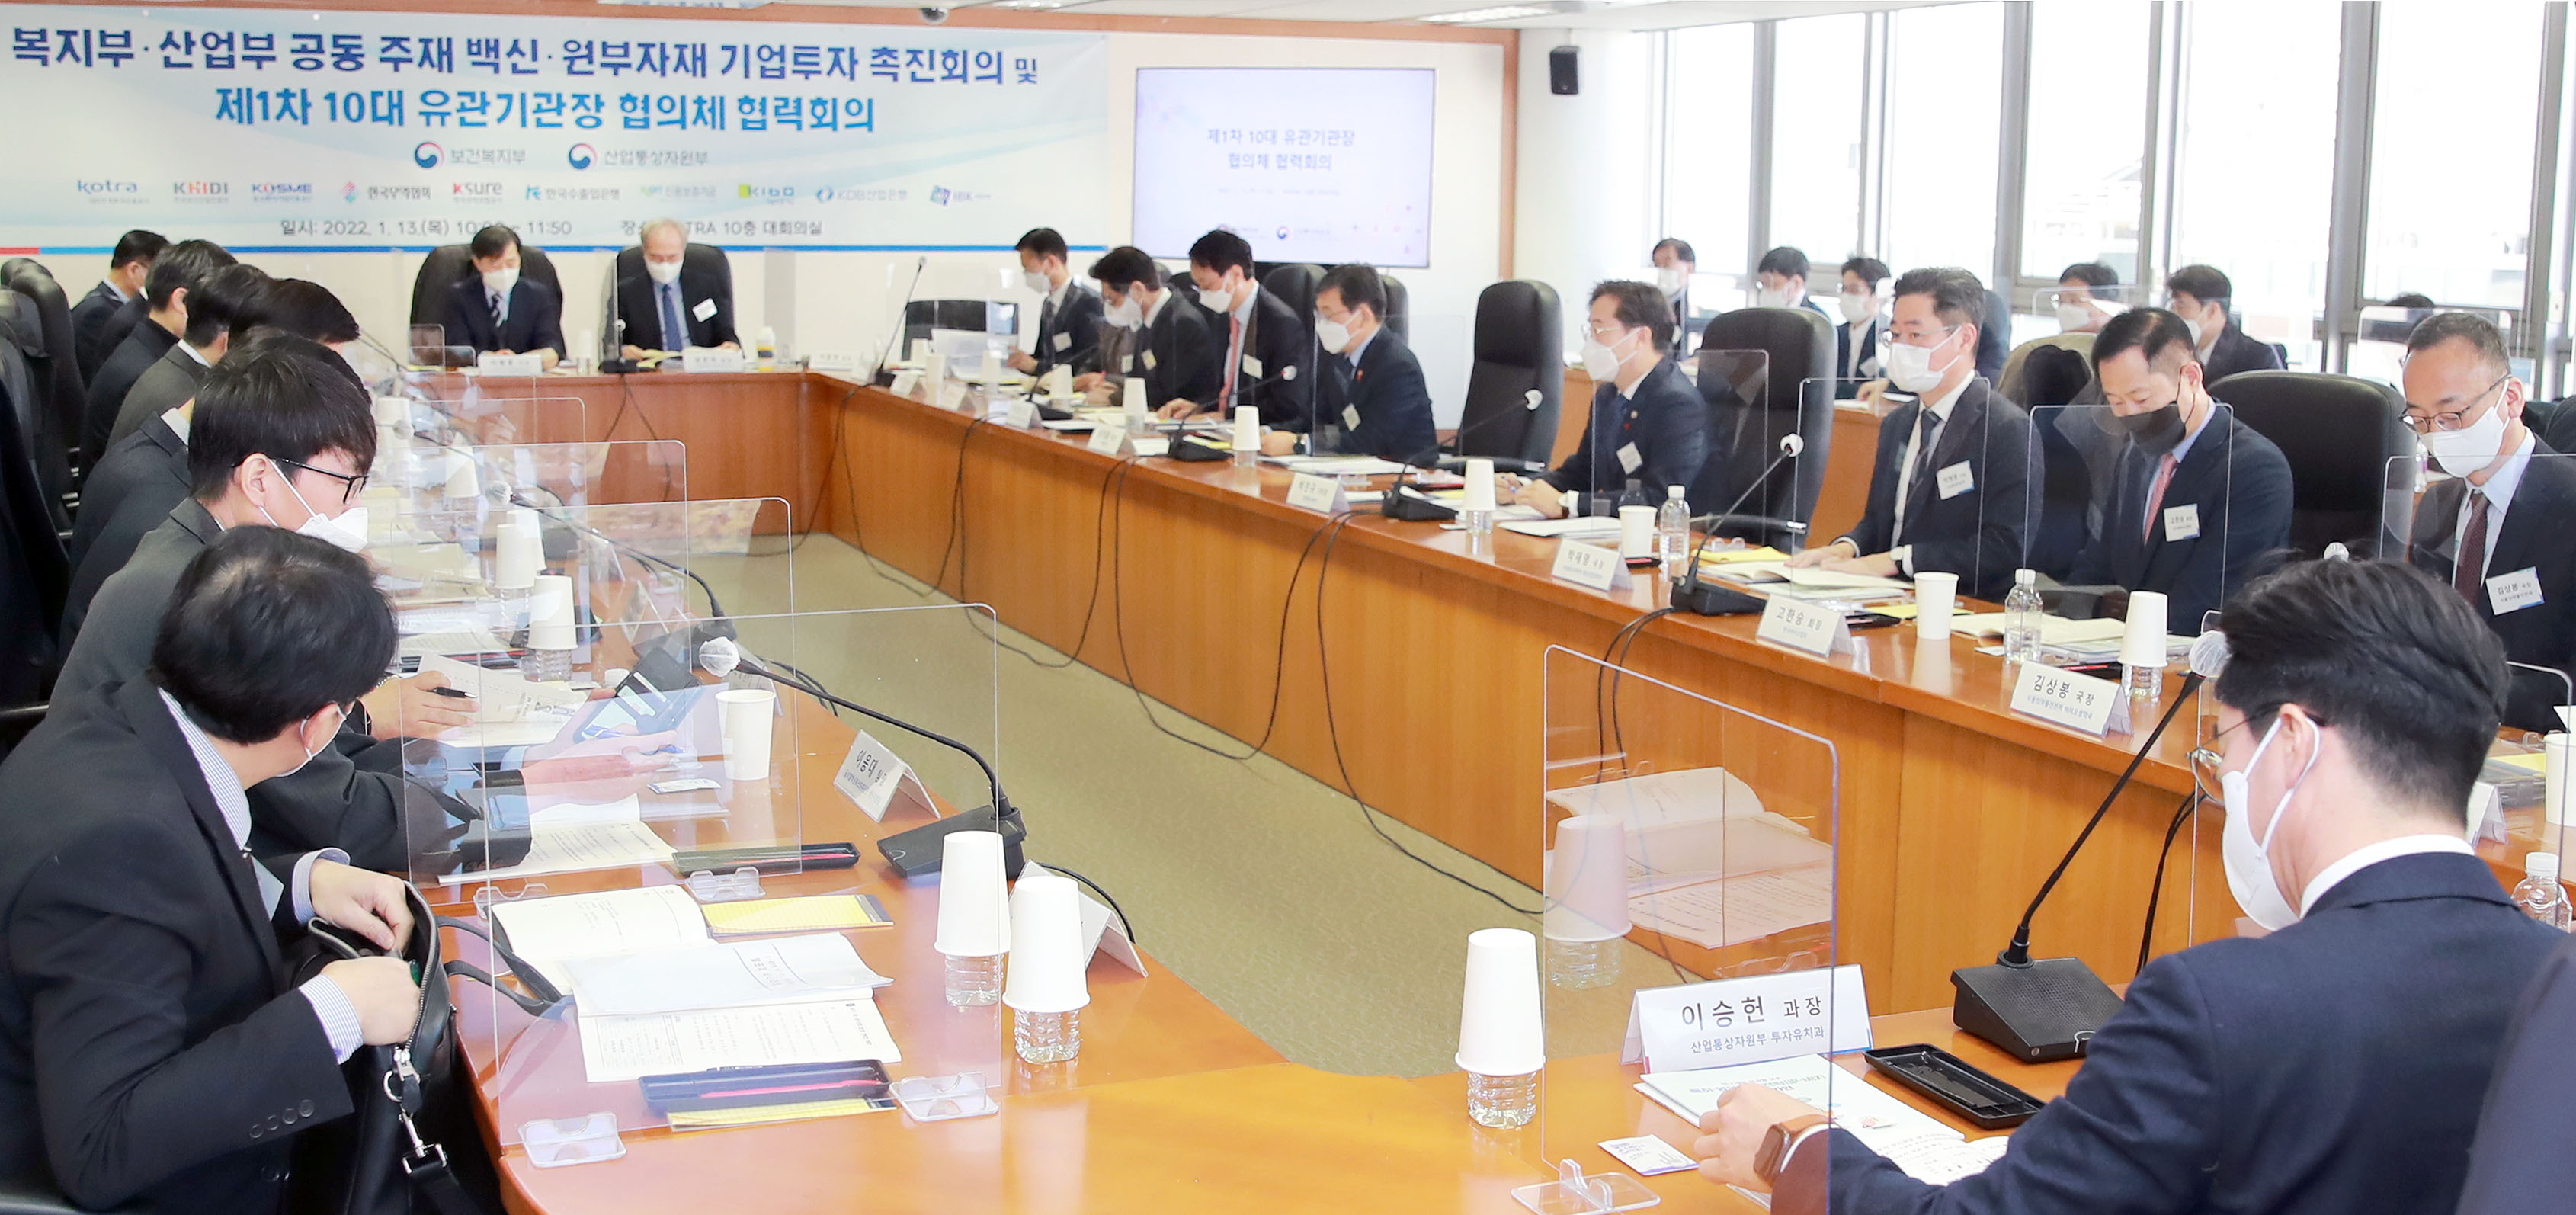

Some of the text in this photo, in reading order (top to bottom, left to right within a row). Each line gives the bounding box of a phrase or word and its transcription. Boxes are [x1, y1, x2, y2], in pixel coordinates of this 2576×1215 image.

[13, 27, 1037, 85] 복지부·산업부 공동 주재 백신·원부자재 기업투자 촉진회의 및
[216, 88, 874, 133] 제1차 10대 유관기관장 협의체 협력회의
[1207, 128, 1355, 147] 제1차 10대 유관기관장
[450, 149, 526, 165] 보건복지부
[605, 149, 709, 167] 산업통상자원부
[1228, 152, 1332, 172] 협의체 협력회의
[77, 179, 138, 195] kotra
[280, 219, 318, 236] 일시:
[527, 221, 573, 236] 11:50
[722, 220, 757, 237] 10층
[763, 220, 822, 238] 대회의실
[2033, 674, 2095, 707] 김상봉 국장
[1682, 995, 1822, 1031] 이승헌 과장
[1690, 1025, 1825, 1053] 산업통상자원부 투자유치과
